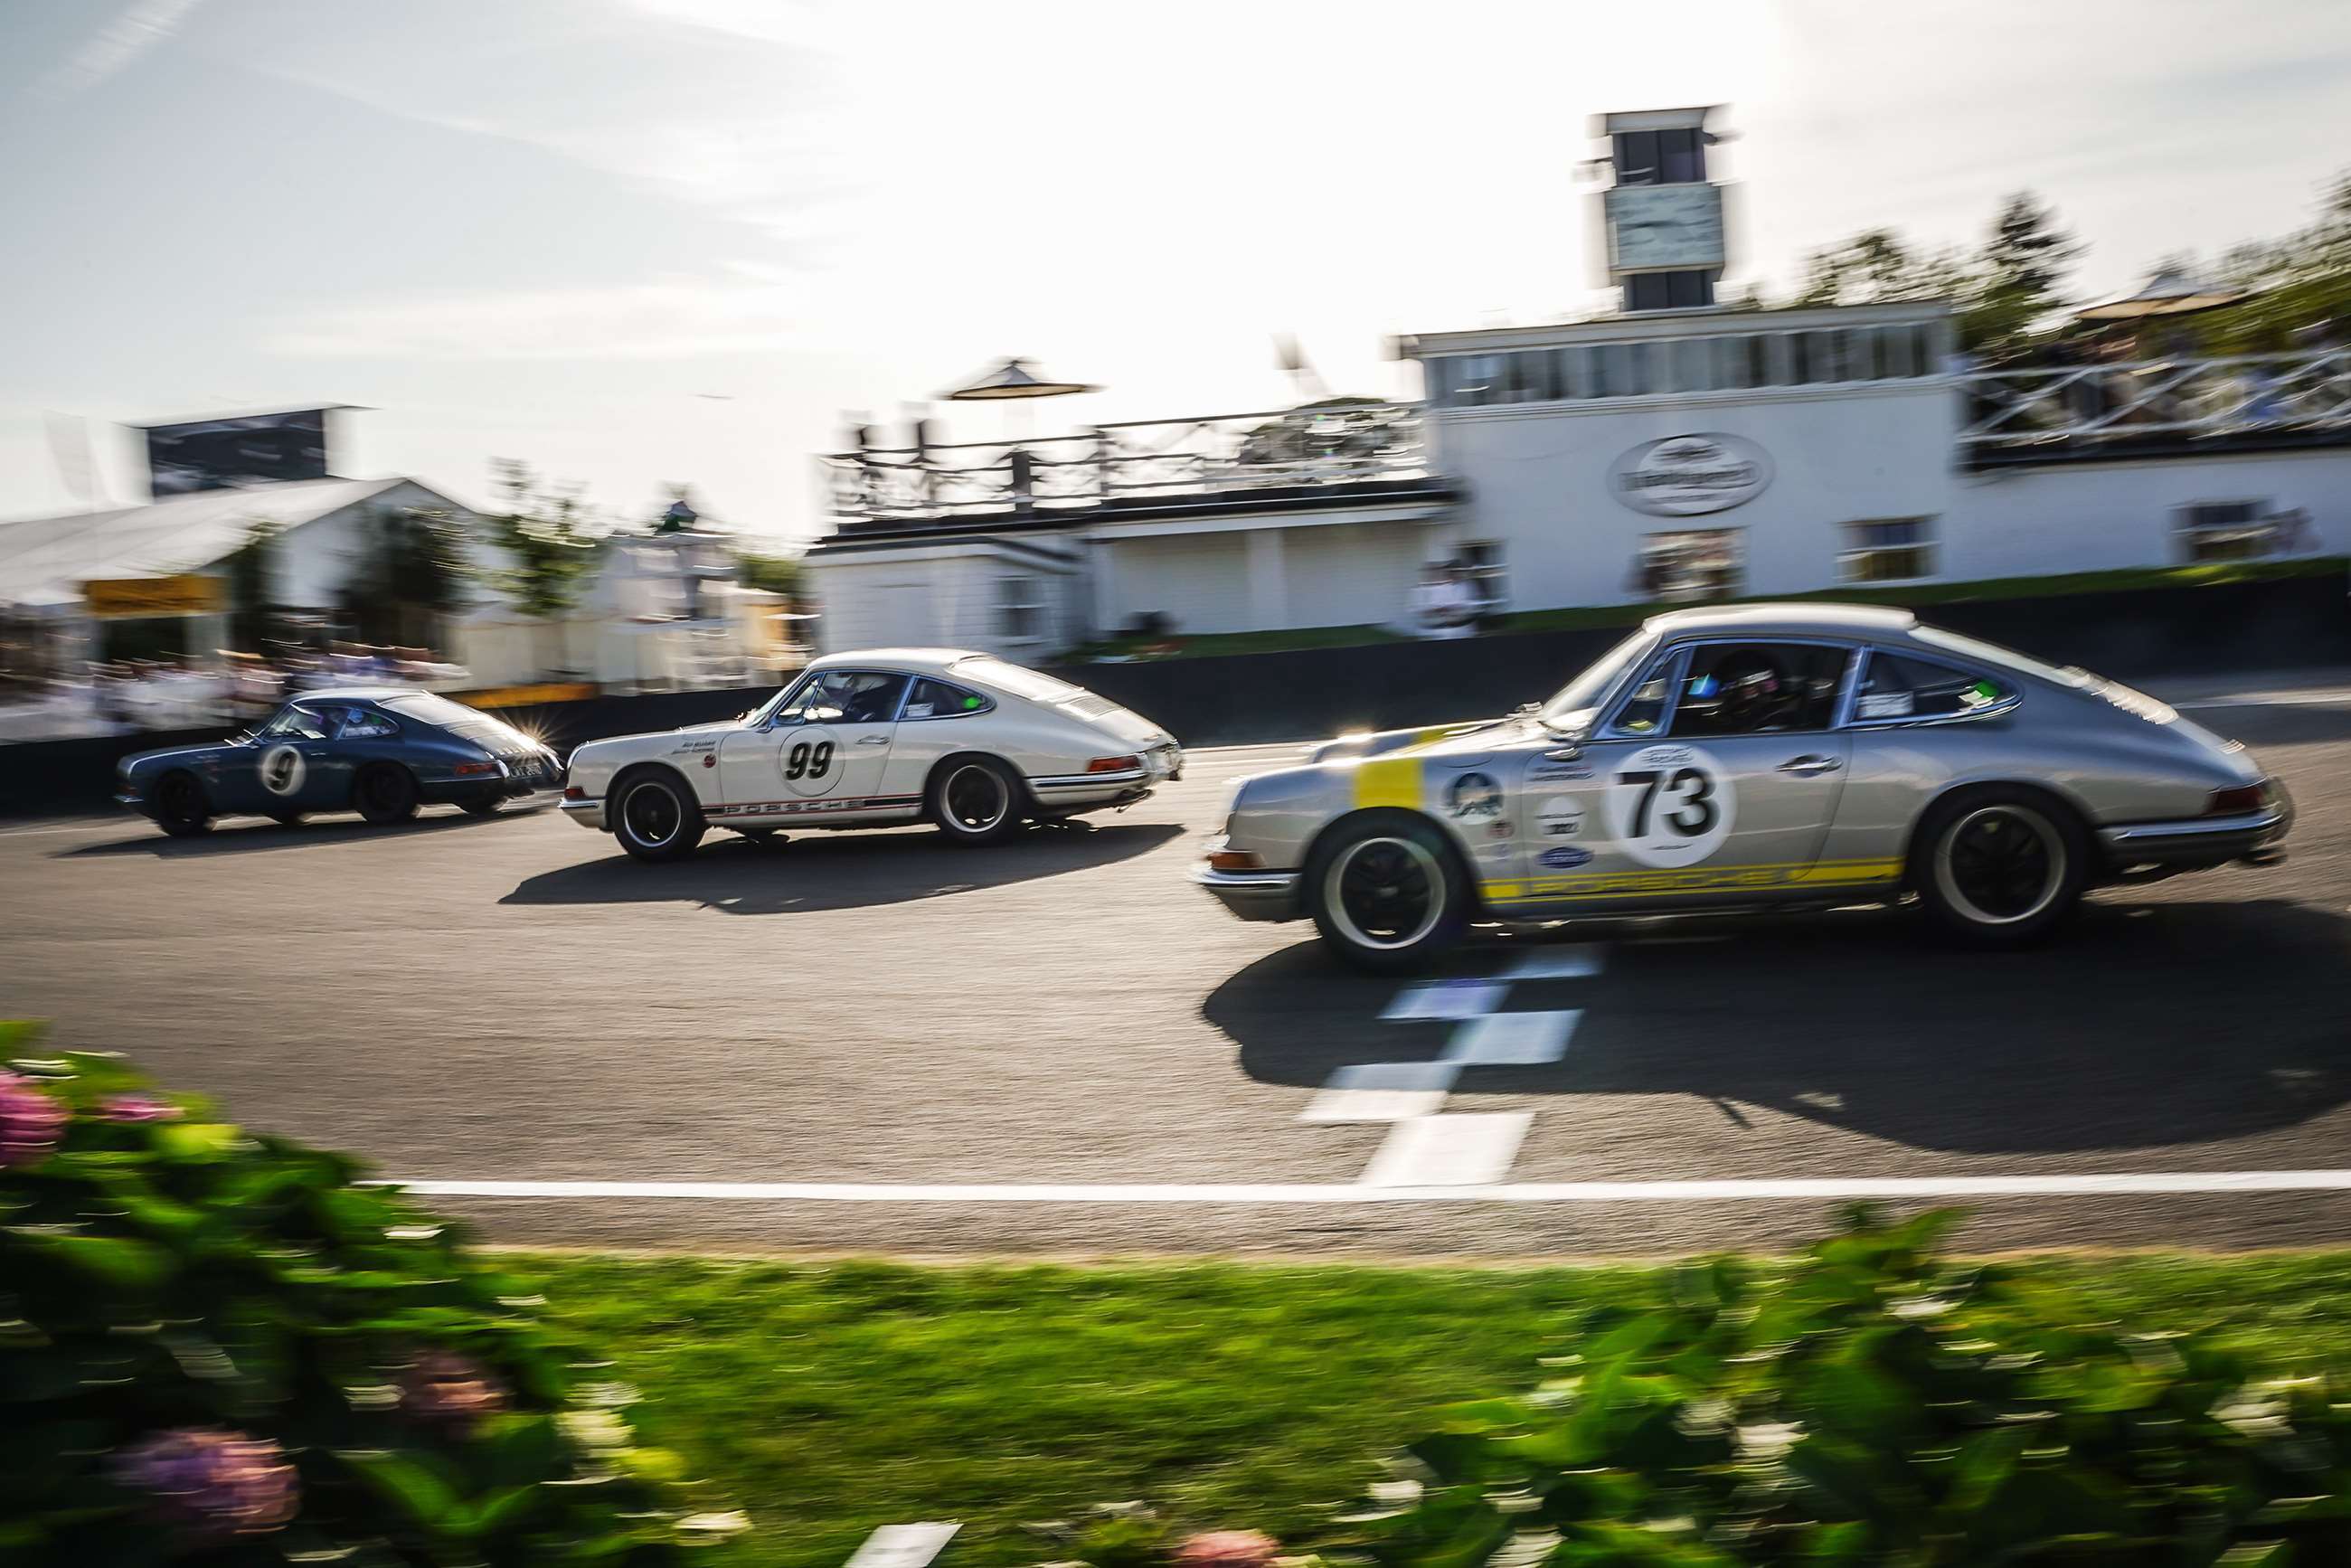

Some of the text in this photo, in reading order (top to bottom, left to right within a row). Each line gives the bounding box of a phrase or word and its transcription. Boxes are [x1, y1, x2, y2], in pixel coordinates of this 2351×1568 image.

[267, 751, 297, 790] 9
[785, 741, 836, 780] 99
[724, 799, 865, 814] PORSCHE
[1619, 768, 1720, 837] 73
